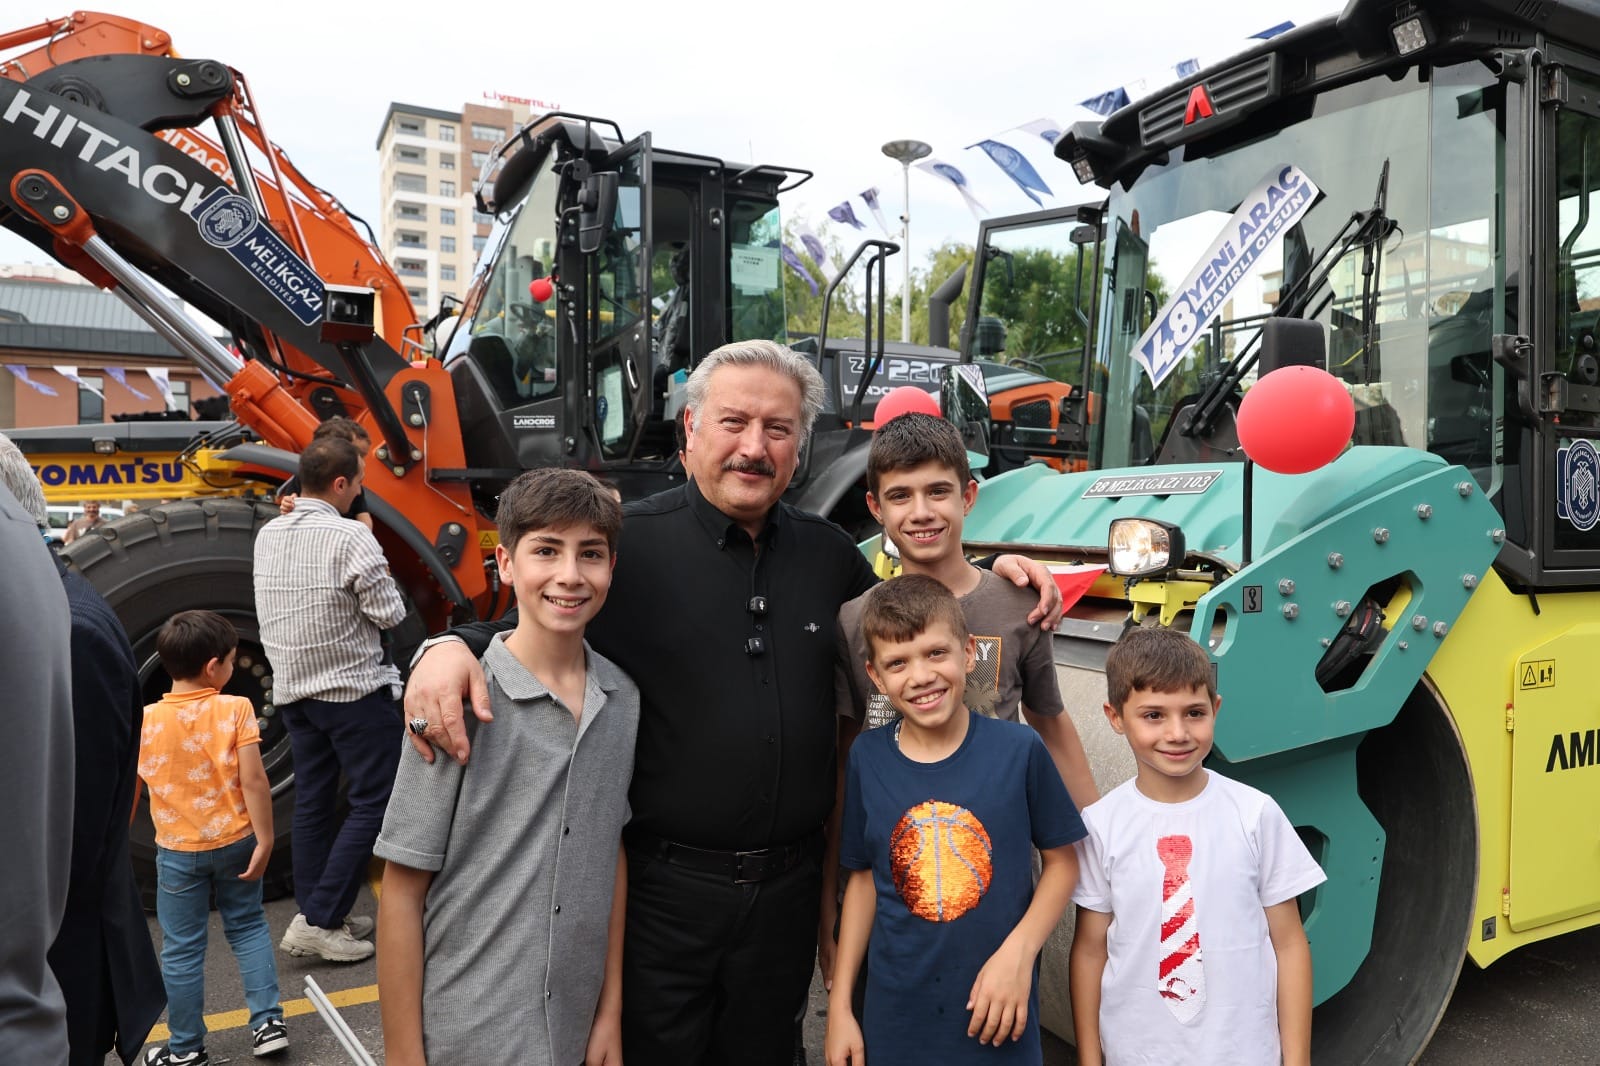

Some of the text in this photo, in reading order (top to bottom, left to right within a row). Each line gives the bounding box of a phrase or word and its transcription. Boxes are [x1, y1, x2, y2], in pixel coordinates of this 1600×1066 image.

[1150, 301, 1198, 372] 48
[1238, 165, 1301, 248] ARAÇ
[1202, 195, 1308, 317] HAYIRLI OLSUN
[32, 457, 183, 486] OMATSU
[1090, 481, 1110, 493] 38
[1182, 475, 1212, 489] 103
